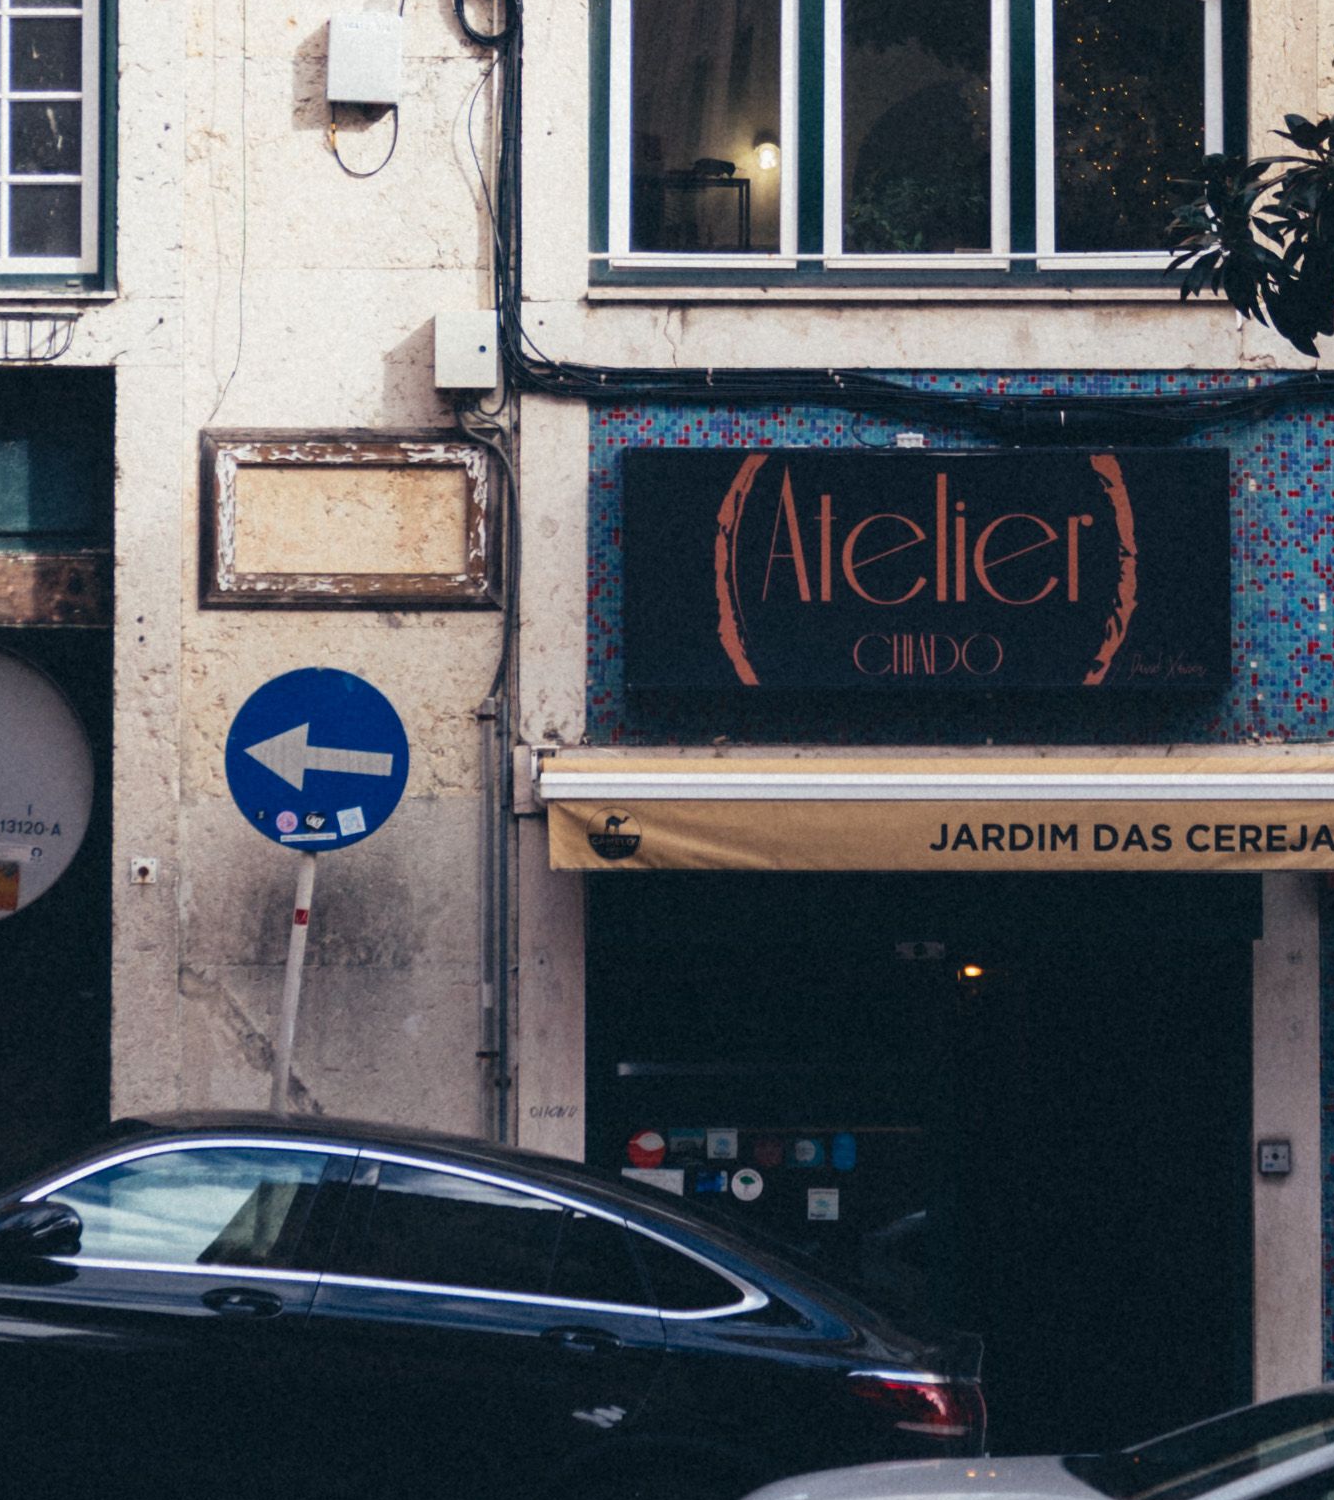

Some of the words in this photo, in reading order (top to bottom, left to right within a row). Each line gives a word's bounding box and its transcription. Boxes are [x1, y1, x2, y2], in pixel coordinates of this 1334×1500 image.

[762, 464, 1094, 606] Atelier
[853, 632, 1004, 676] CHIADO
[929, 823, 1080, 853] JARDIM
[1092, 823, 1173, 853] DAS
